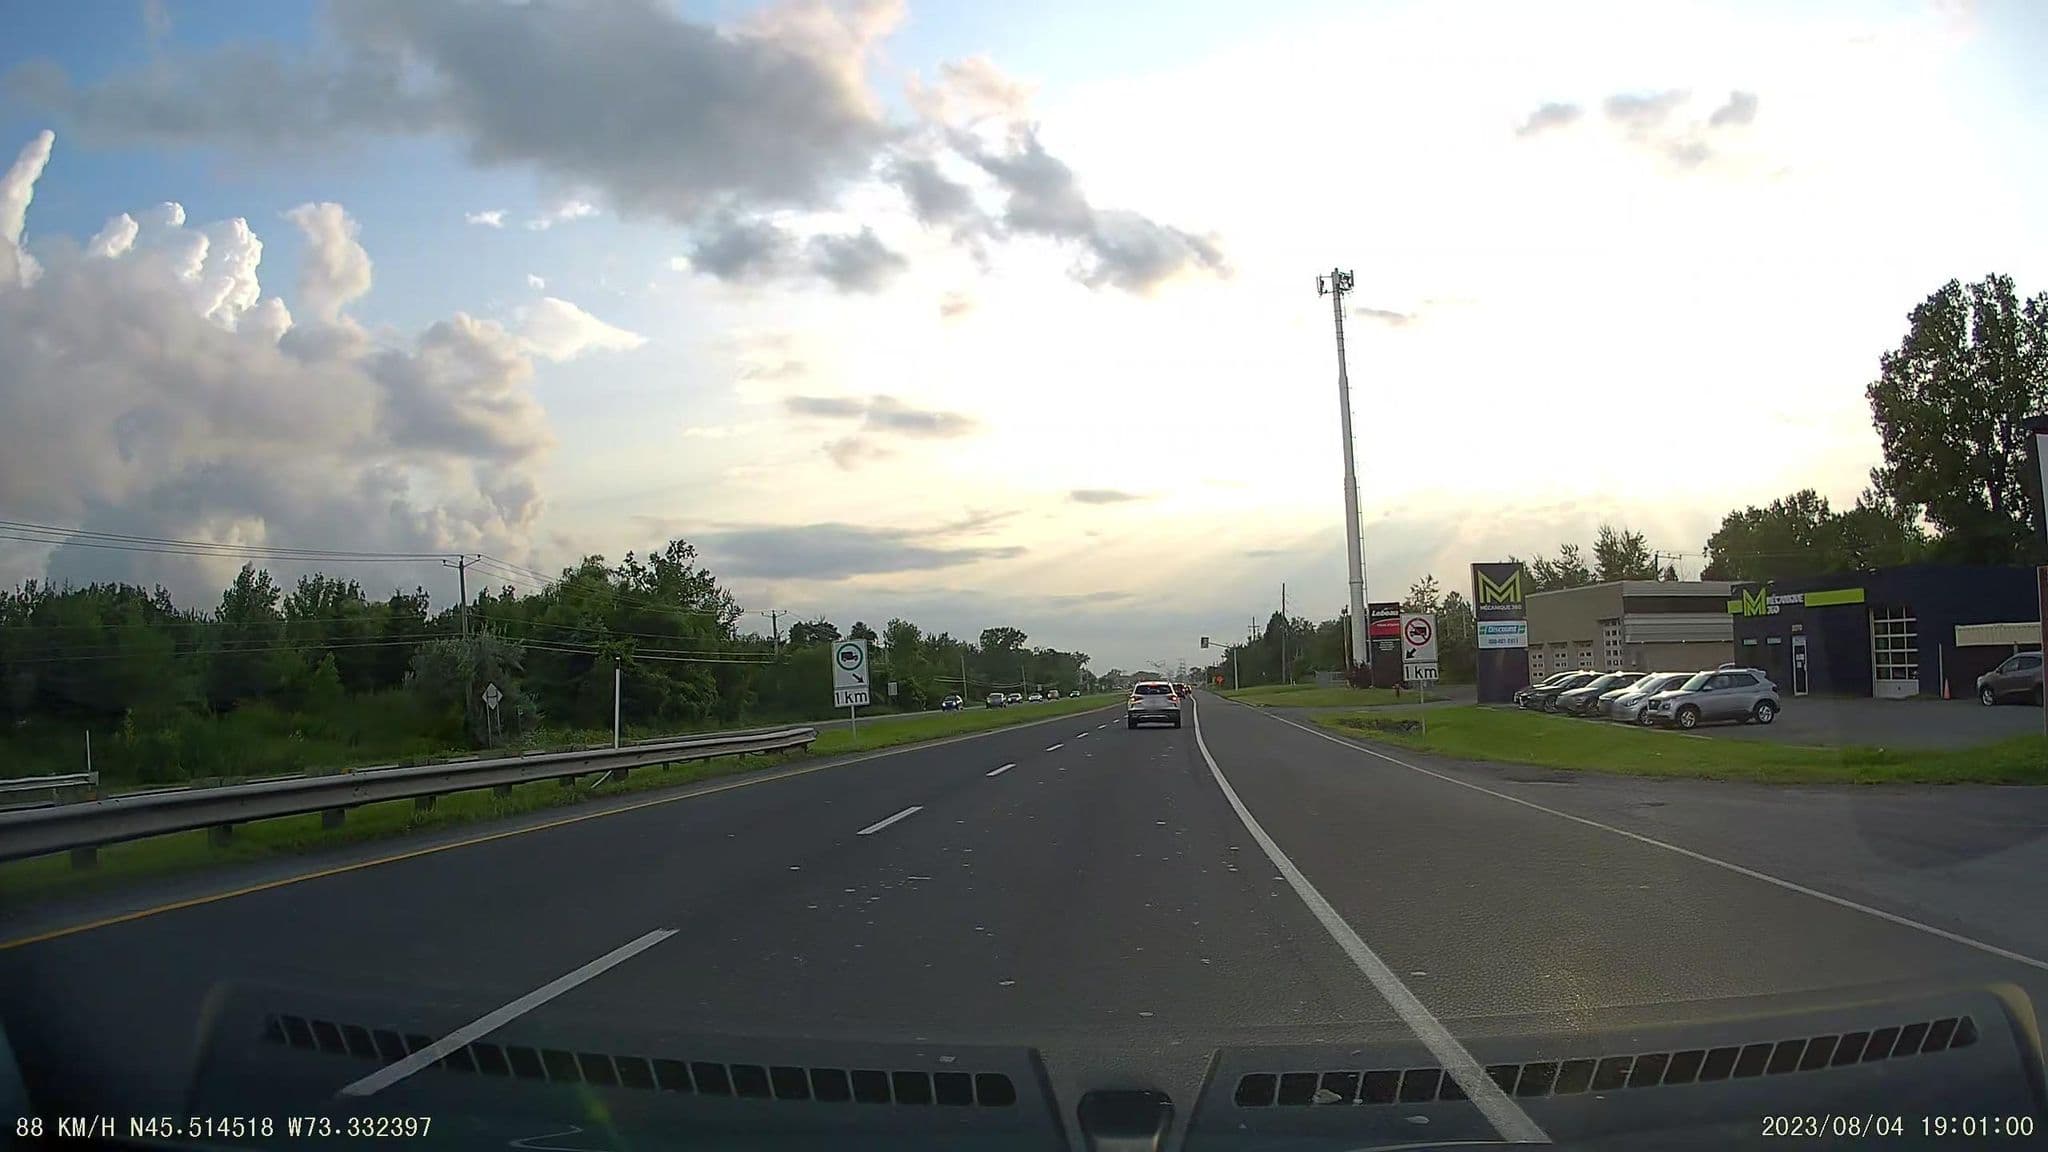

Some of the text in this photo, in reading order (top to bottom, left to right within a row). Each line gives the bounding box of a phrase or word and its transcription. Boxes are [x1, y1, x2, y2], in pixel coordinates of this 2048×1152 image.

[1488, 626, 1517, 634] Discount
[1415, 665, 1438, 679] km
[845, 691, 868, 704] km
